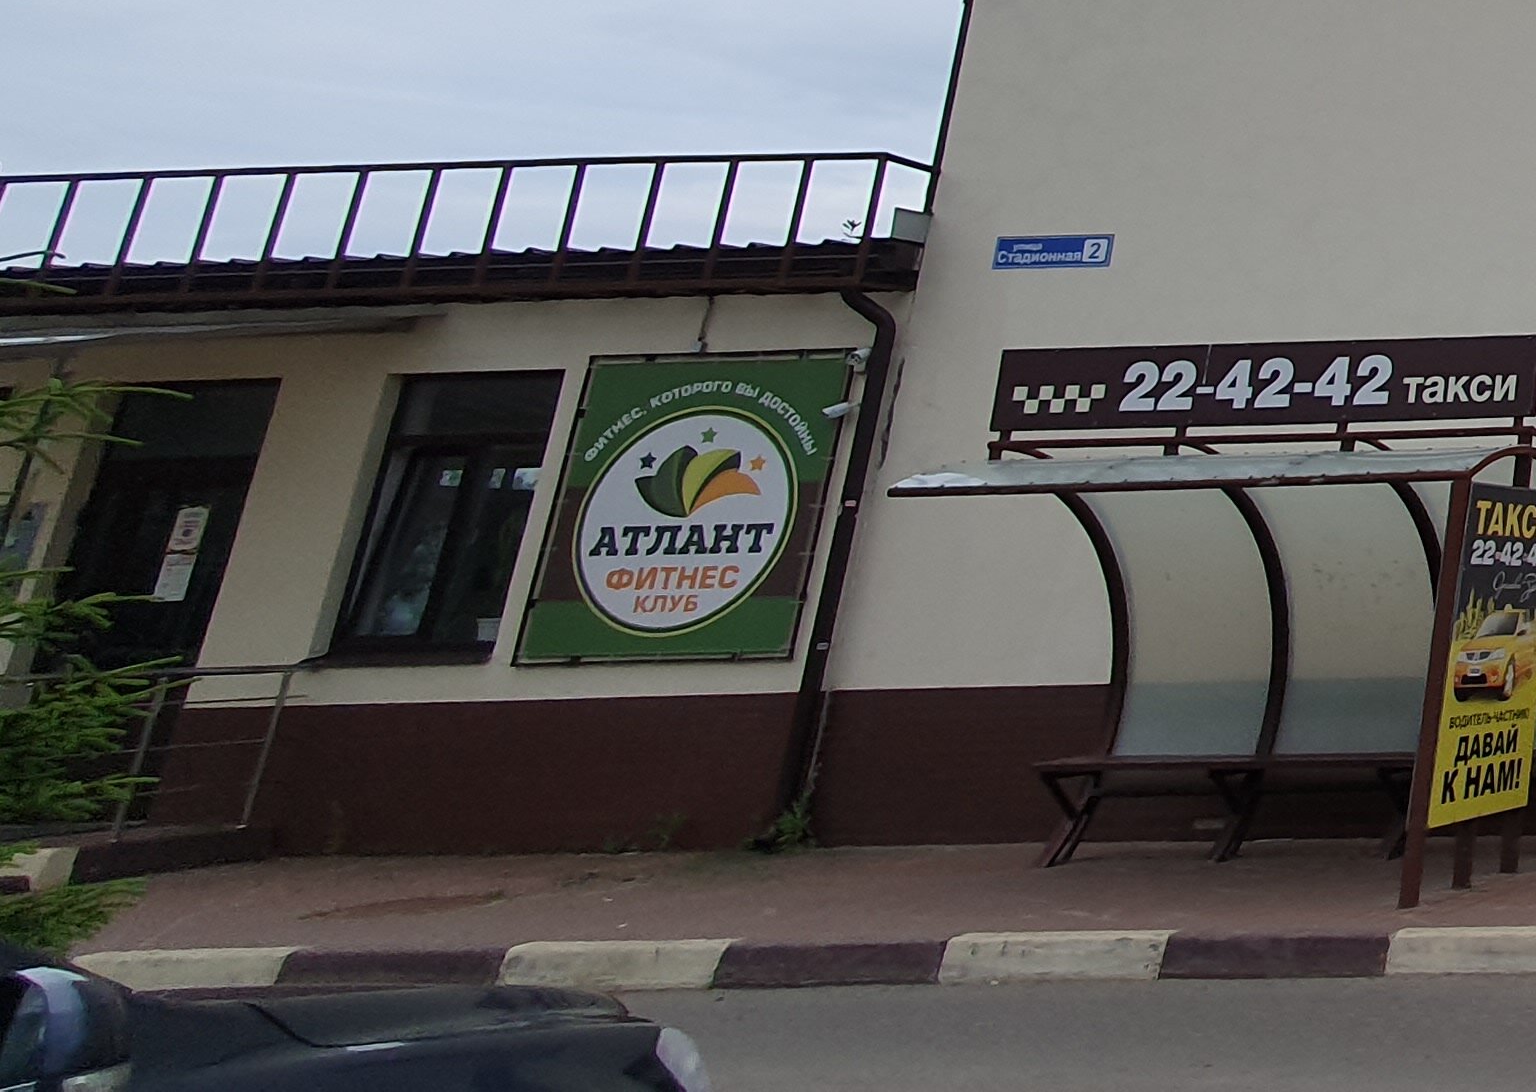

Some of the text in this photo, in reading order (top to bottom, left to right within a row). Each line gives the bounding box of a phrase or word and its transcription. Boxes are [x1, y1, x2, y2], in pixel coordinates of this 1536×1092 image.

[997, 242, 1102, 264] Стадионная 2
[1118, 354, 1518, 412] 22-42-42 такси
[650, 380, 733, 409] КОТОРОГО
[735, 382, 761, 399] ВЫ
[758, 391, 817, 457] ДОСТОЙНЫ
[588, 522, 775, 557] АТЛАНТ
[605, 565, 741, 591] ФИТНЕС
[632, 594, 699, 614] КЛУБ
[1453, 723, 1519, 768] ДАВАЙ
[1440, 757, 1523, 805] К НАМ!
